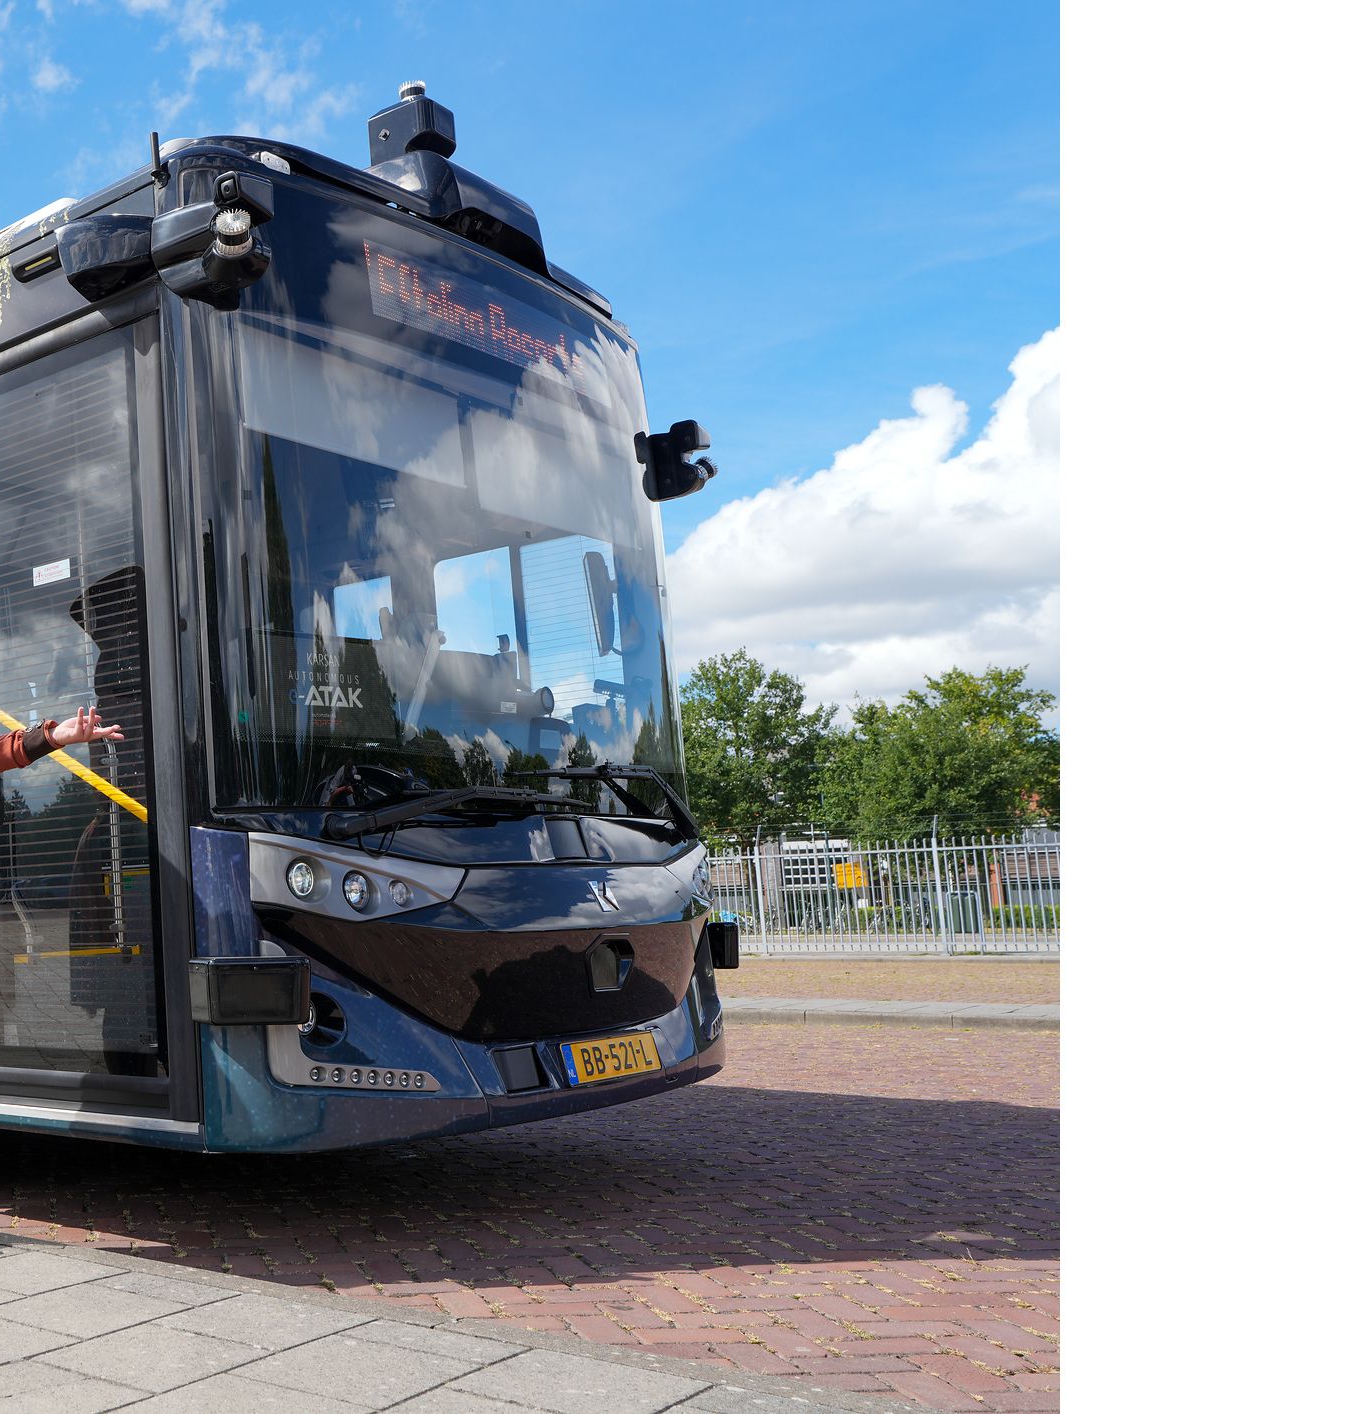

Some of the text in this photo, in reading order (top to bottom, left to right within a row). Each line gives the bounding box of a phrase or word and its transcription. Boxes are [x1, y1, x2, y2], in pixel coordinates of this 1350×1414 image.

[306, 652, 340, 667] KARSAN
[288, 670, 360, 685] AUTONOMOUS
[580, 1039, 653, 1077] BB-521-L
[567, 1068, 577, 1079] NL
